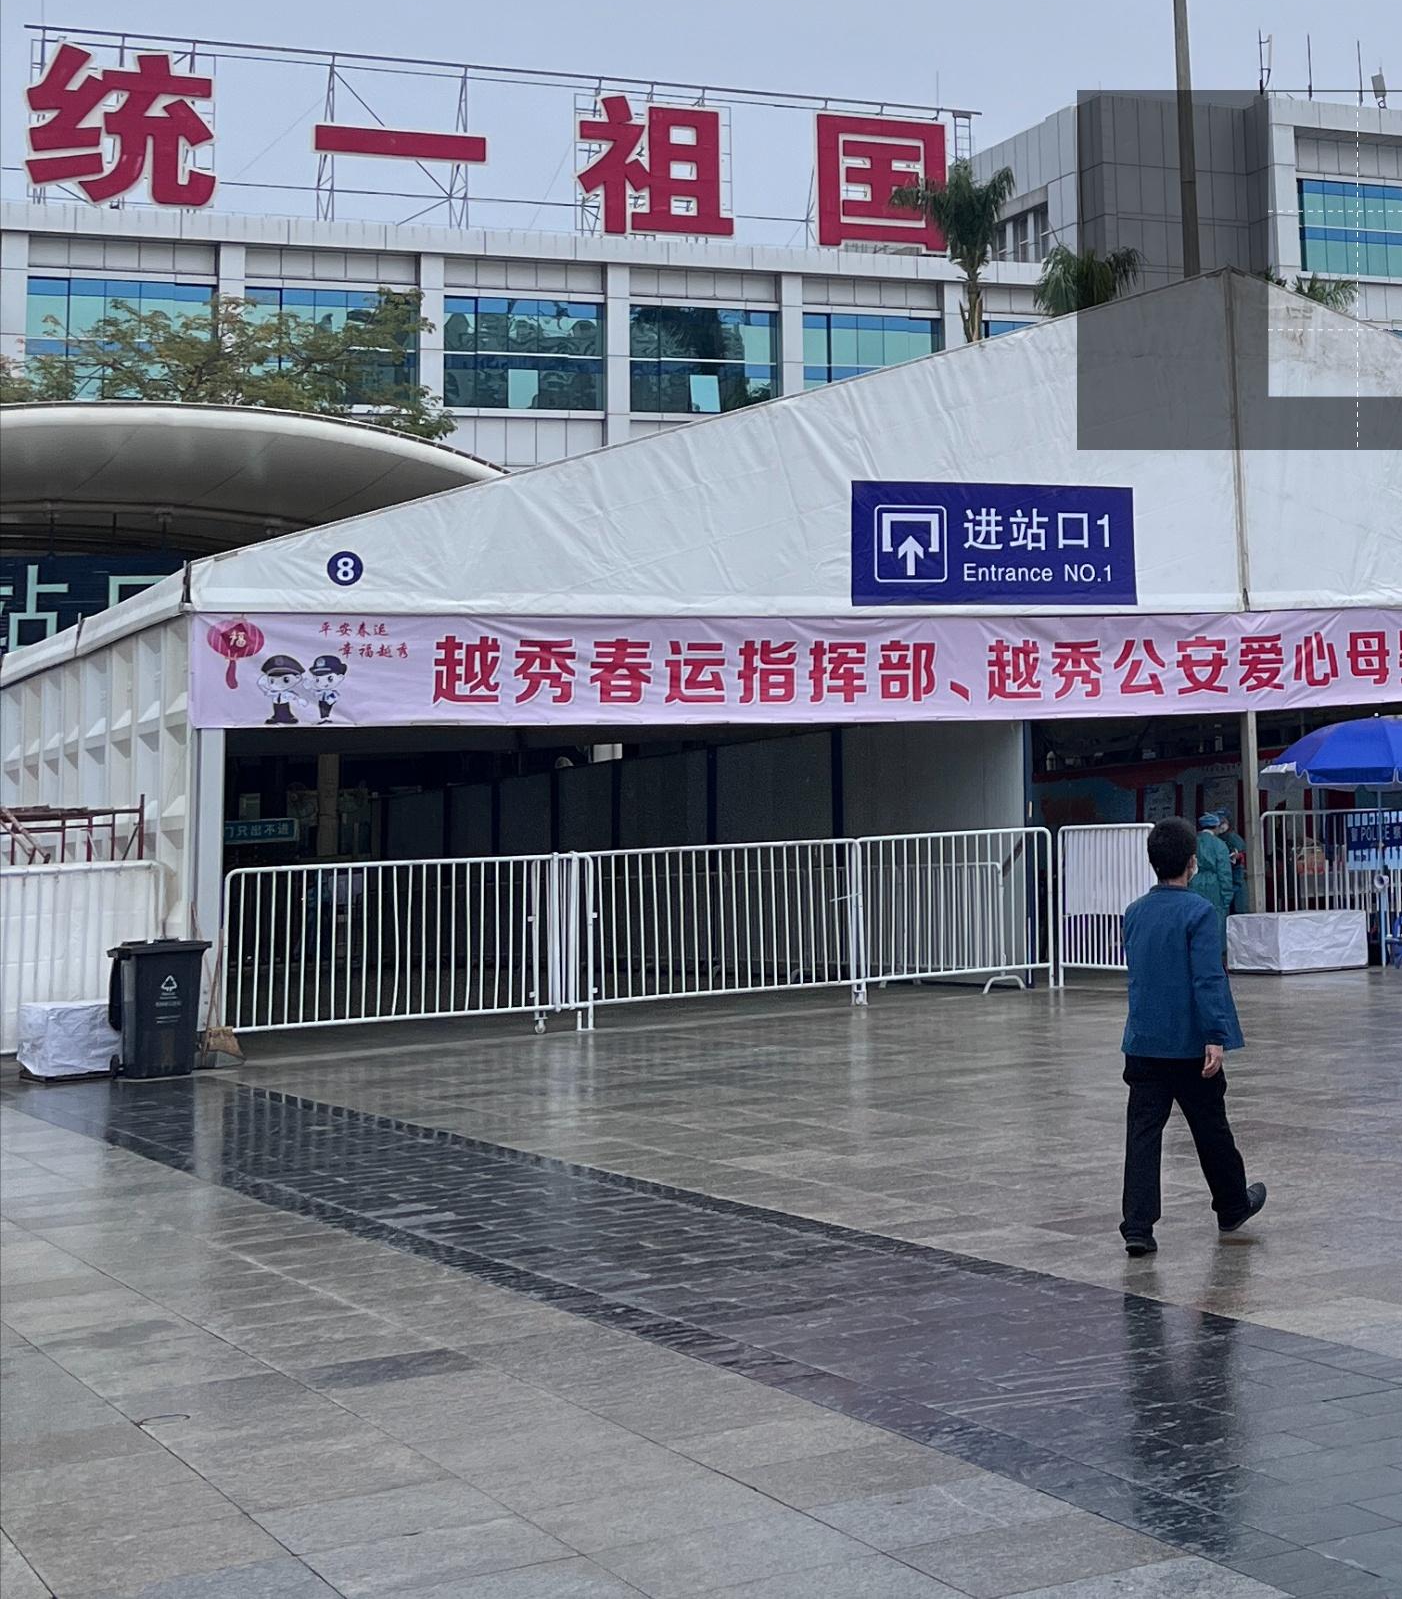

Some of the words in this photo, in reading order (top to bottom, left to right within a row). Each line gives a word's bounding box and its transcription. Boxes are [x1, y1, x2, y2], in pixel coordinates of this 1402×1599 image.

[25, 42, 947, 251] 统一祖国
[963, 507, 1112, 551] 进站口1
[336, 557, 354, 581] 8
[963, 563, 1053, 583] Entrance
[1064, 563, 1112, 583] NO.1
[228, 630, 247, 649] 福
[319, 620, 389, 638] 平安春运
